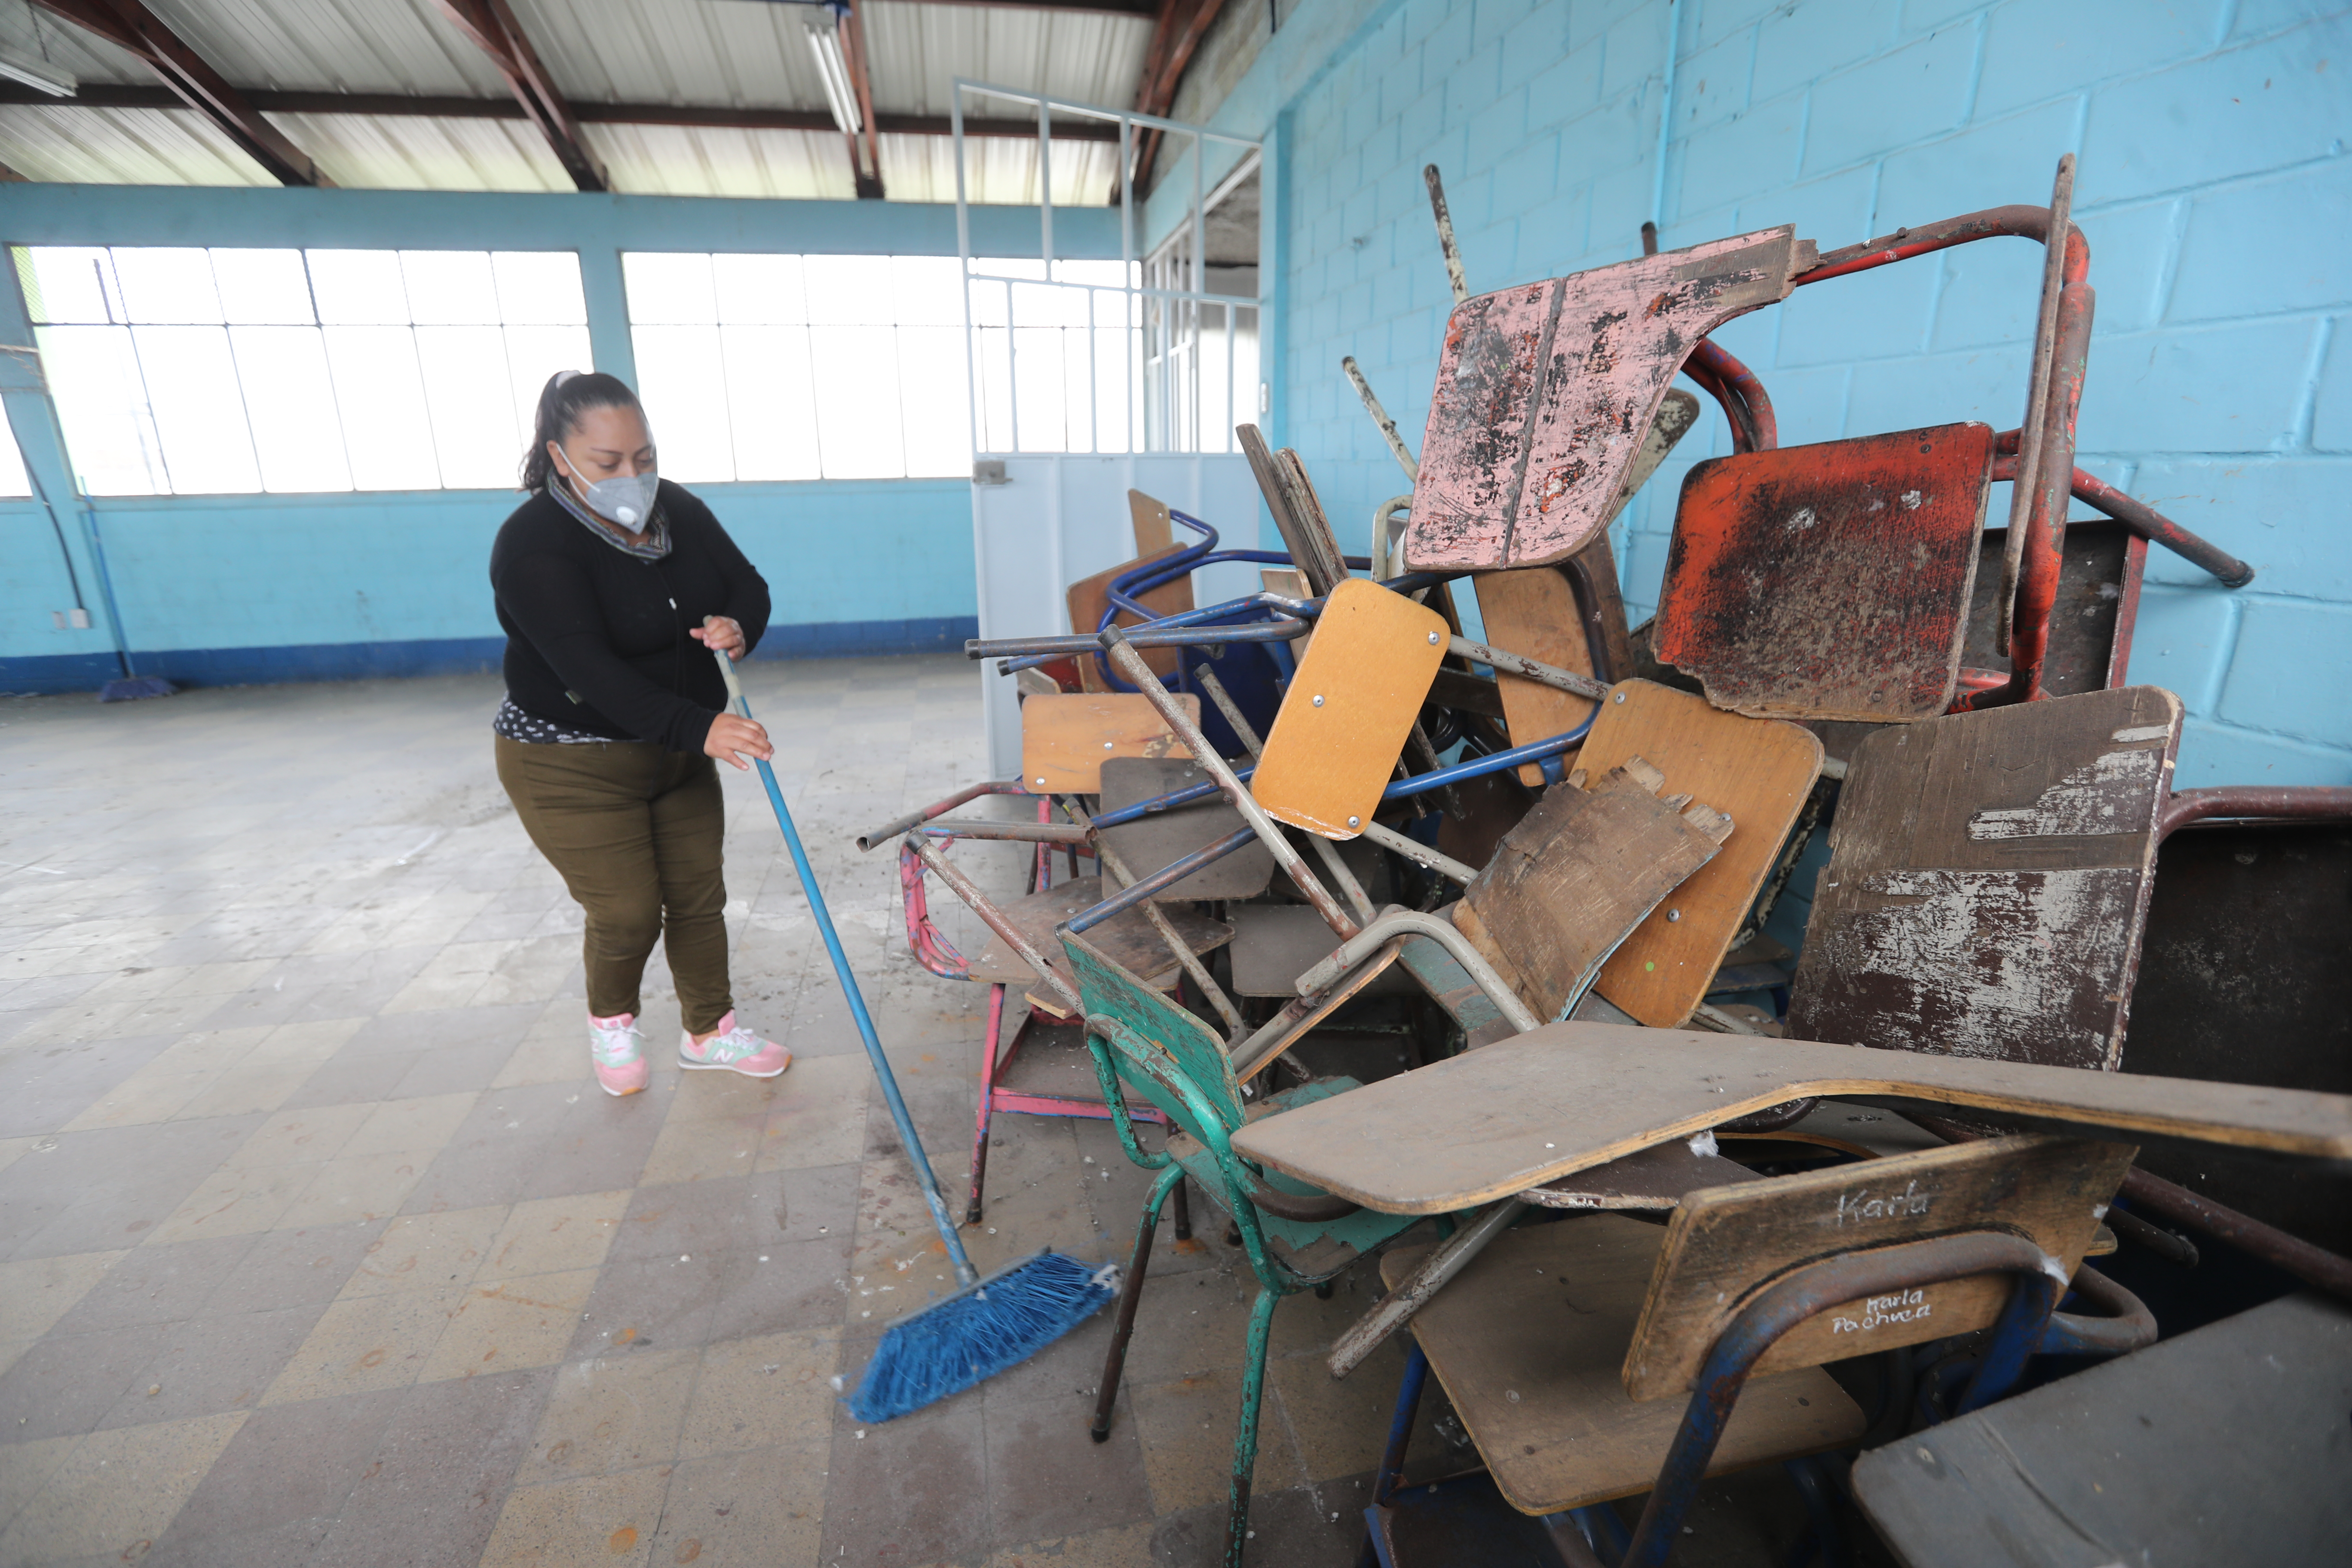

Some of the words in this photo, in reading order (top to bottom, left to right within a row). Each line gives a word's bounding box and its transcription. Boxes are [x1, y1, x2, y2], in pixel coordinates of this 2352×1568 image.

[710, 1047, 735, 1064] N
[1837, 1179, 1928, 1228] Karla
[1866, 1288, 1923, 1314] Karla
